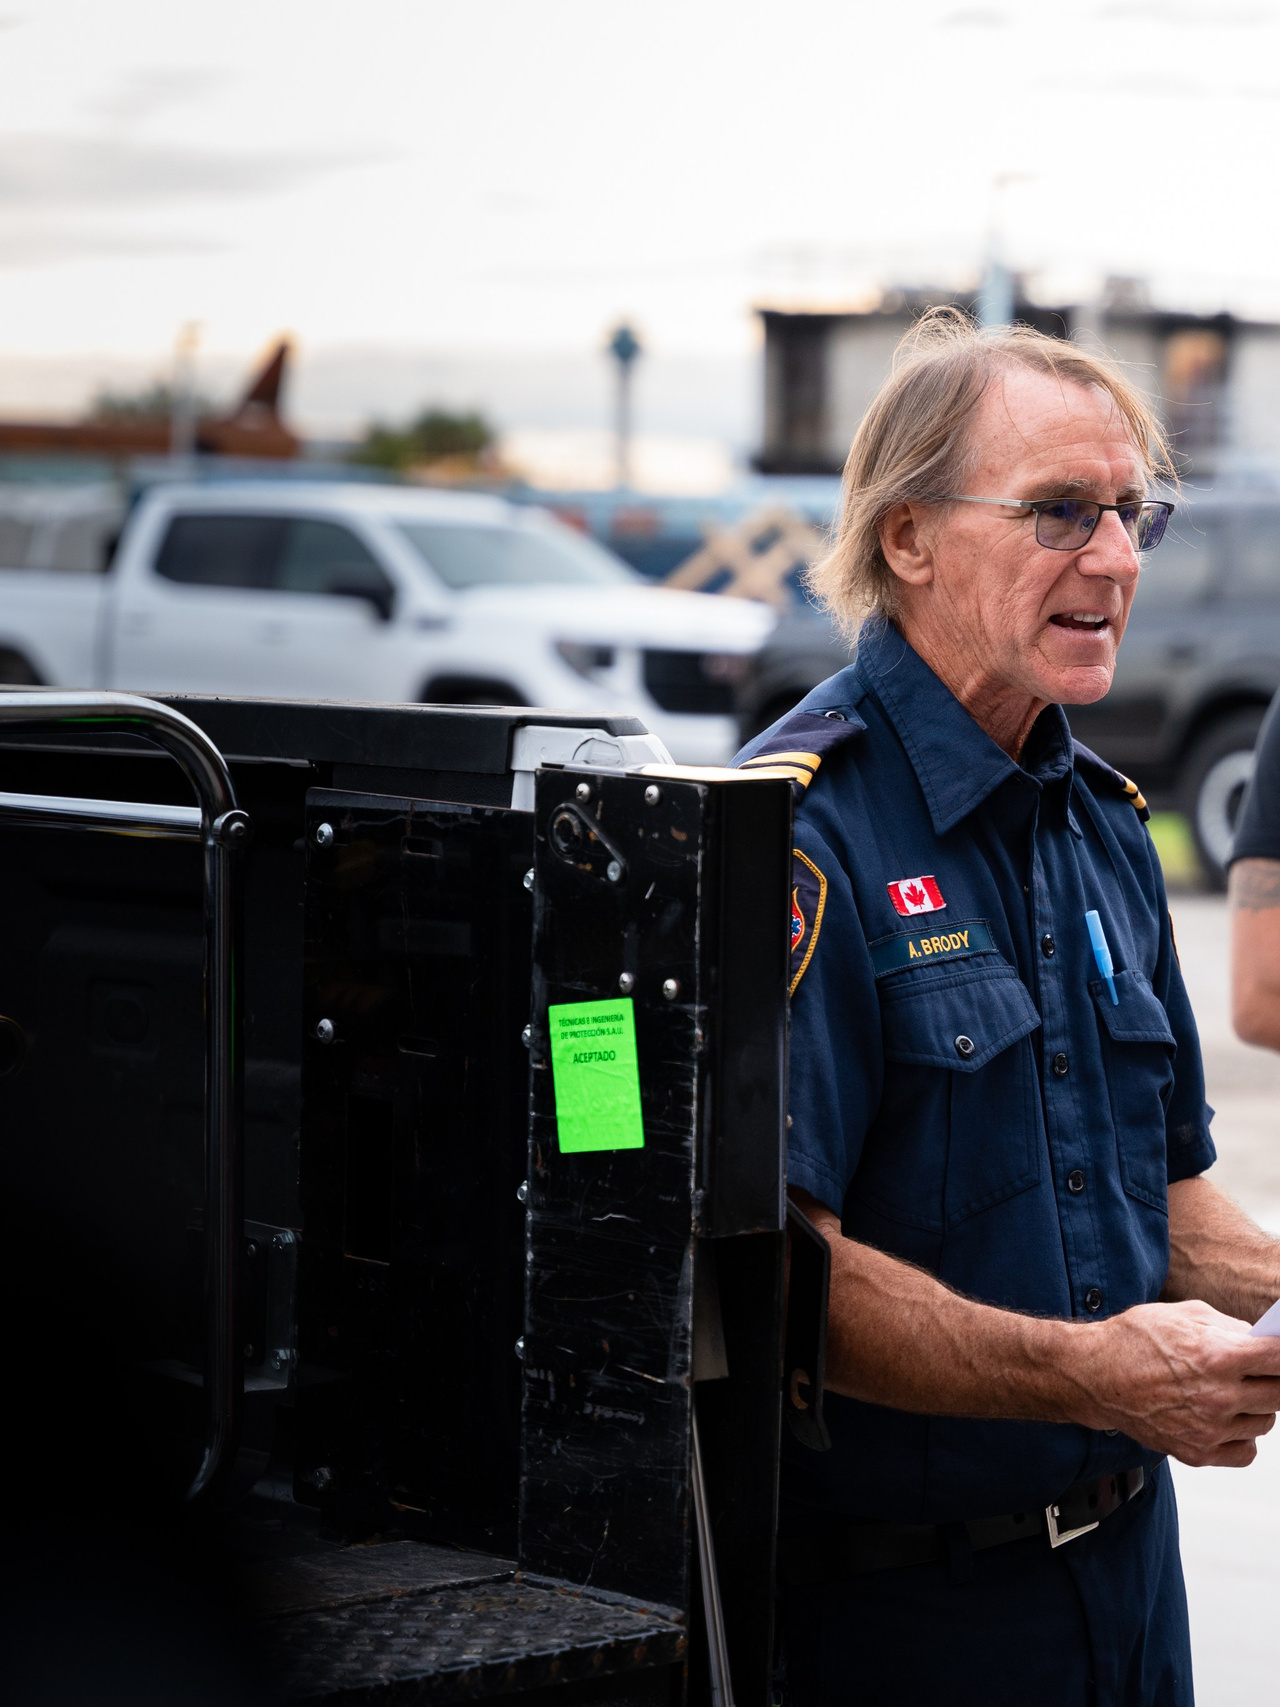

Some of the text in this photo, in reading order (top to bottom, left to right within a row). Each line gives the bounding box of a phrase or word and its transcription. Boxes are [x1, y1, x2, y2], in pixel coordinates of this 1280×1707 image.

[558, 1013, 624, 1027] TÉCNICAS E INGENIERÍA
[561, 1027, 624, 1040] DE PROTECCIÓN S.A.U.
[573, 1050, 616, 1064] ACEPTADO
